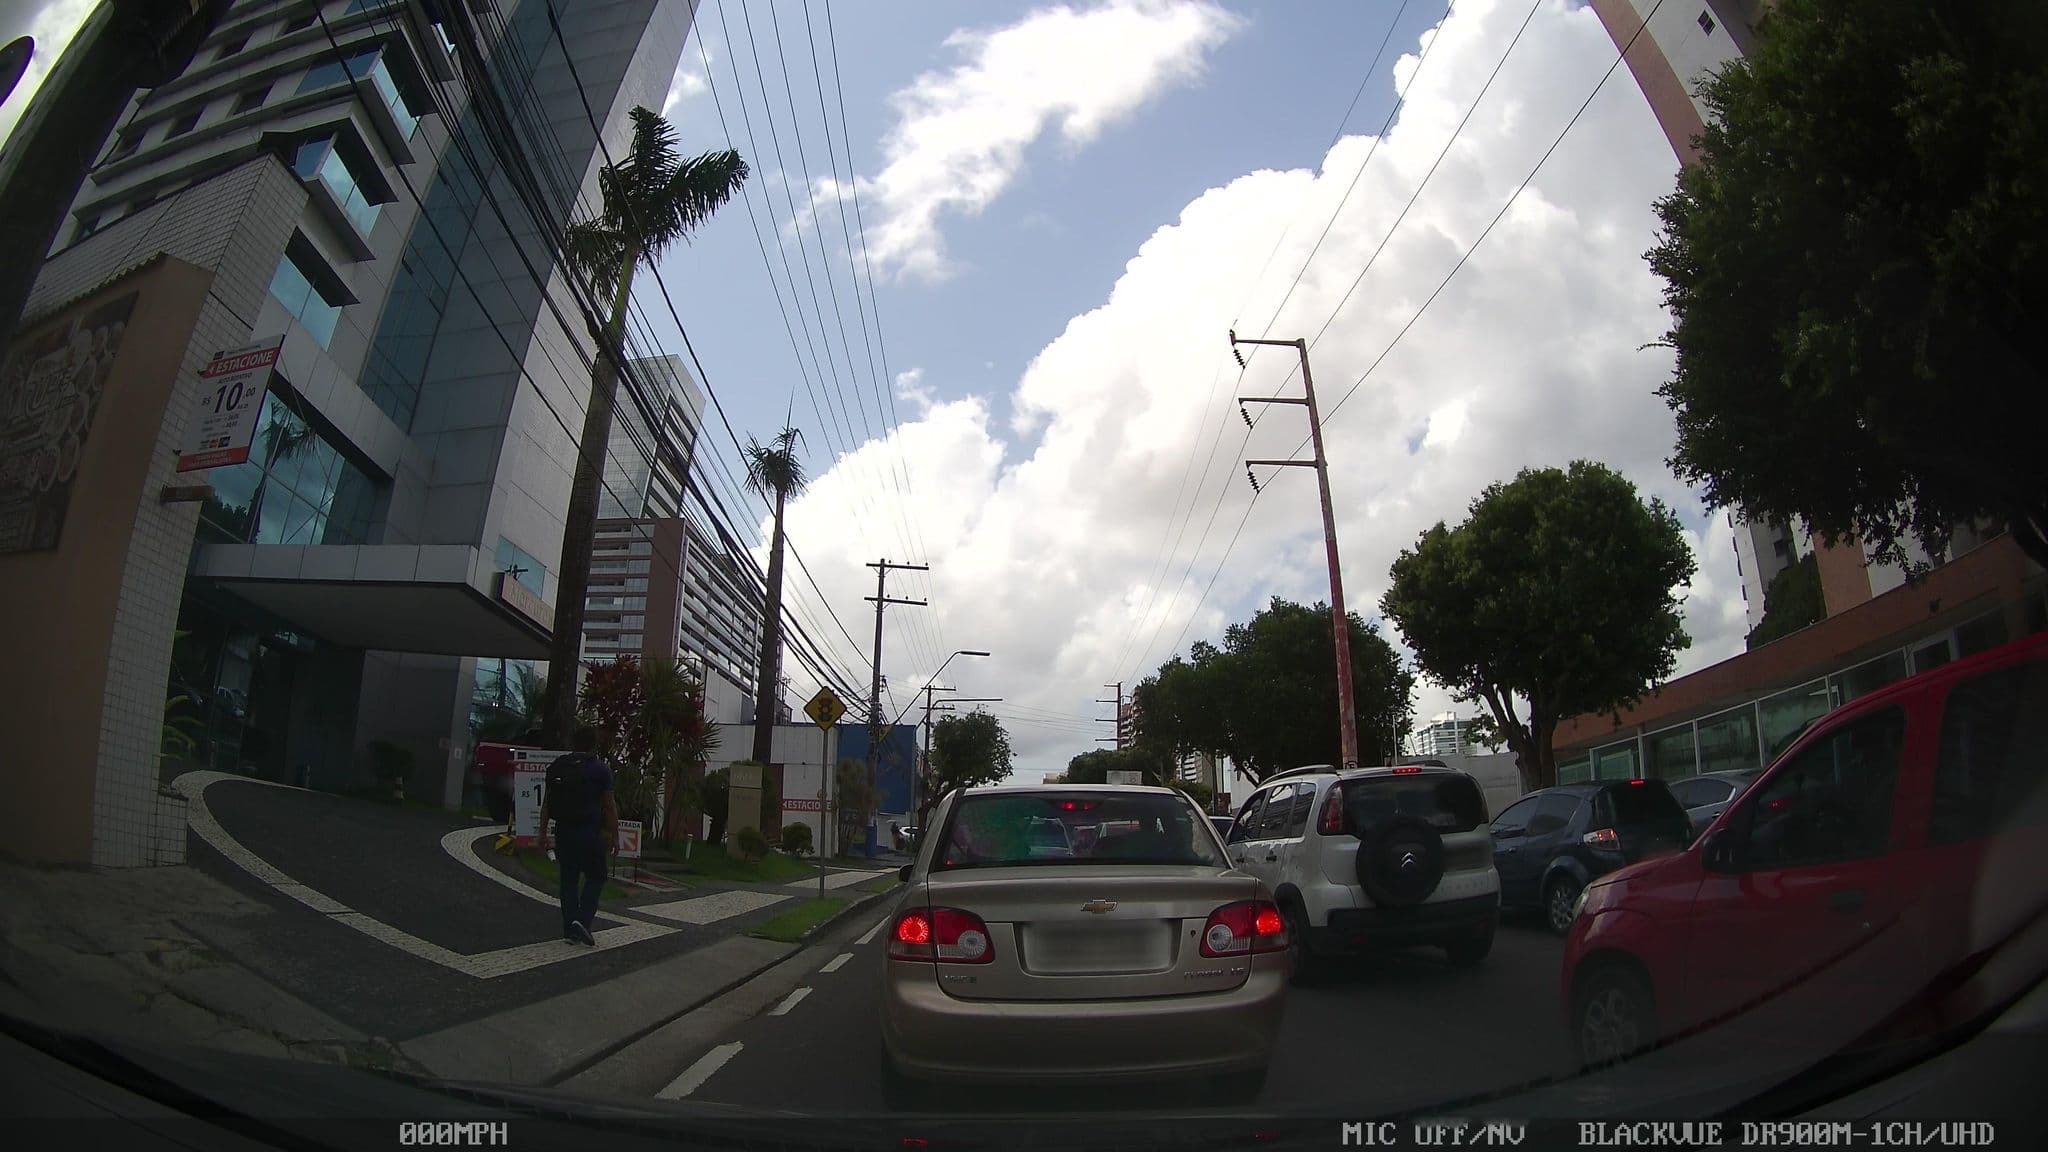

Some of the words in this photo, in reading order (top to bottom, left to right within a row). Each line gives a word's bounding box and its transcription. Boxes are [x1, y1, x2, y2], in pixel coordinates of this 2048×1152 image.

[217, 350, 274, 373] ESTACIONE
[523, 763, 545, 772] ESTA
[787, 801, 831, 810] ESTACIOE
